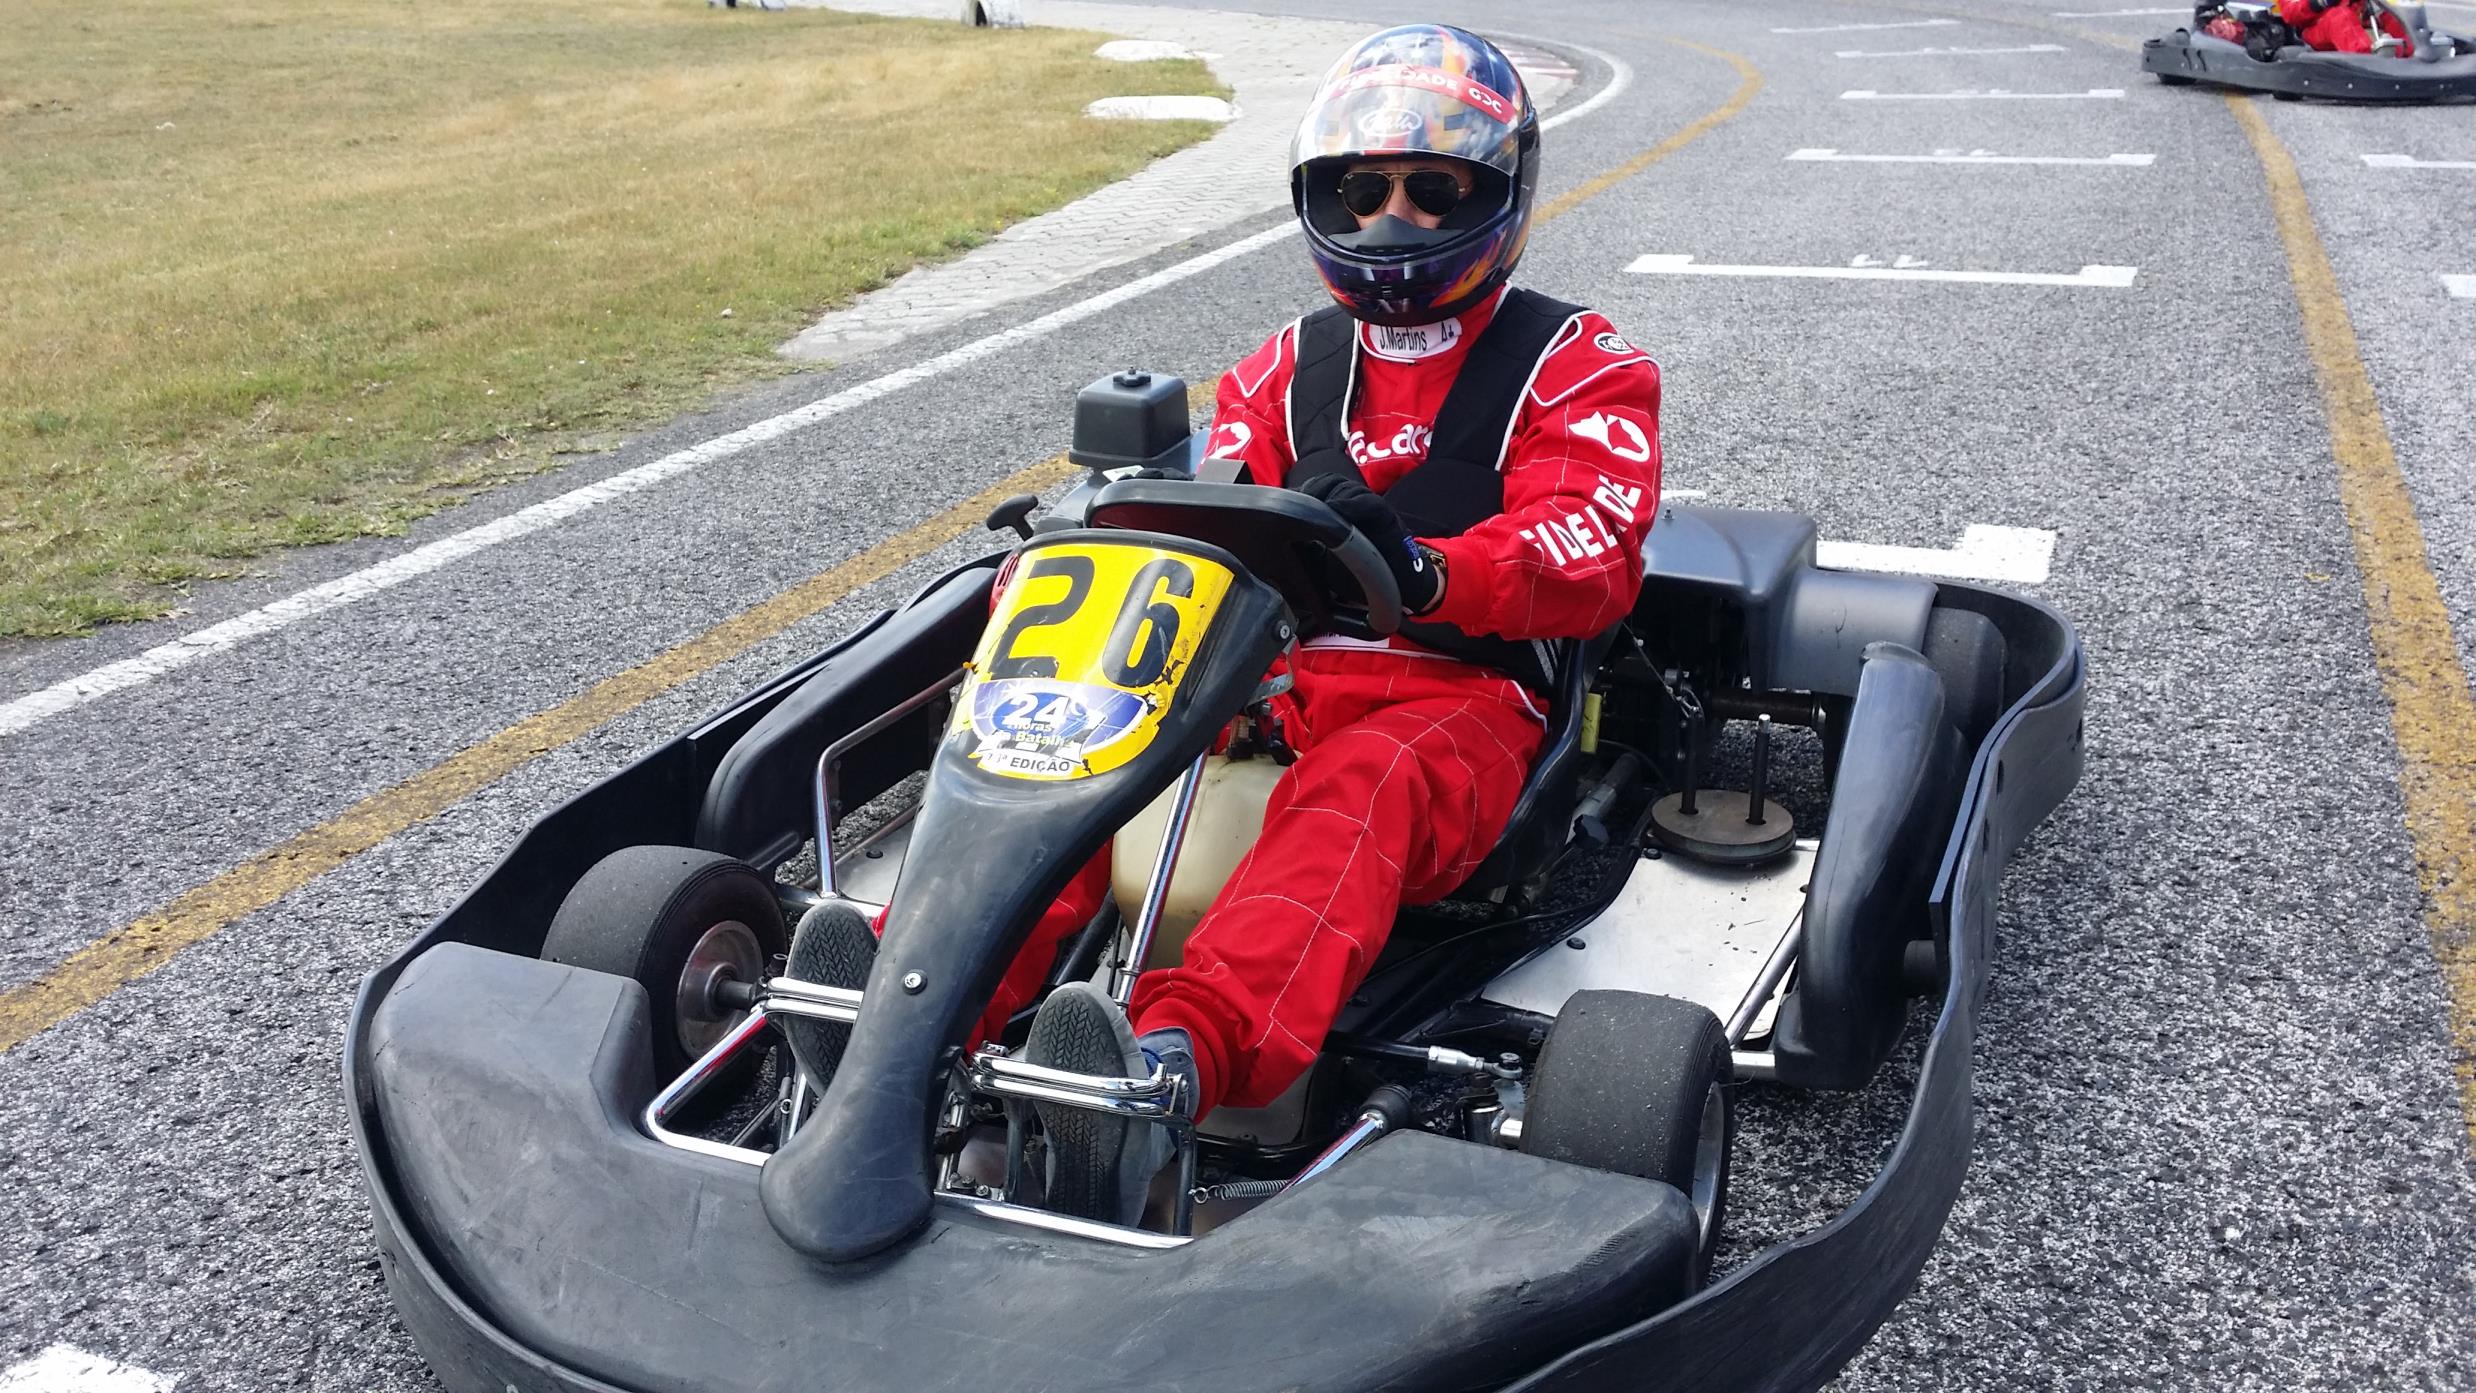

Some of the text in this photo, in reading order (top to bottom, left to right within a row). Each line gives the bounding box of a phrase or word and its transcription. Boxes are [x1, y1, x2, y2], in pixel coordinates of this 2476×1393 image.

[989, 556, 1195, 688] 26
[1001, 692, 1071, 726] 24
[1009, 754, 1071, 773] EDIÇÃO
